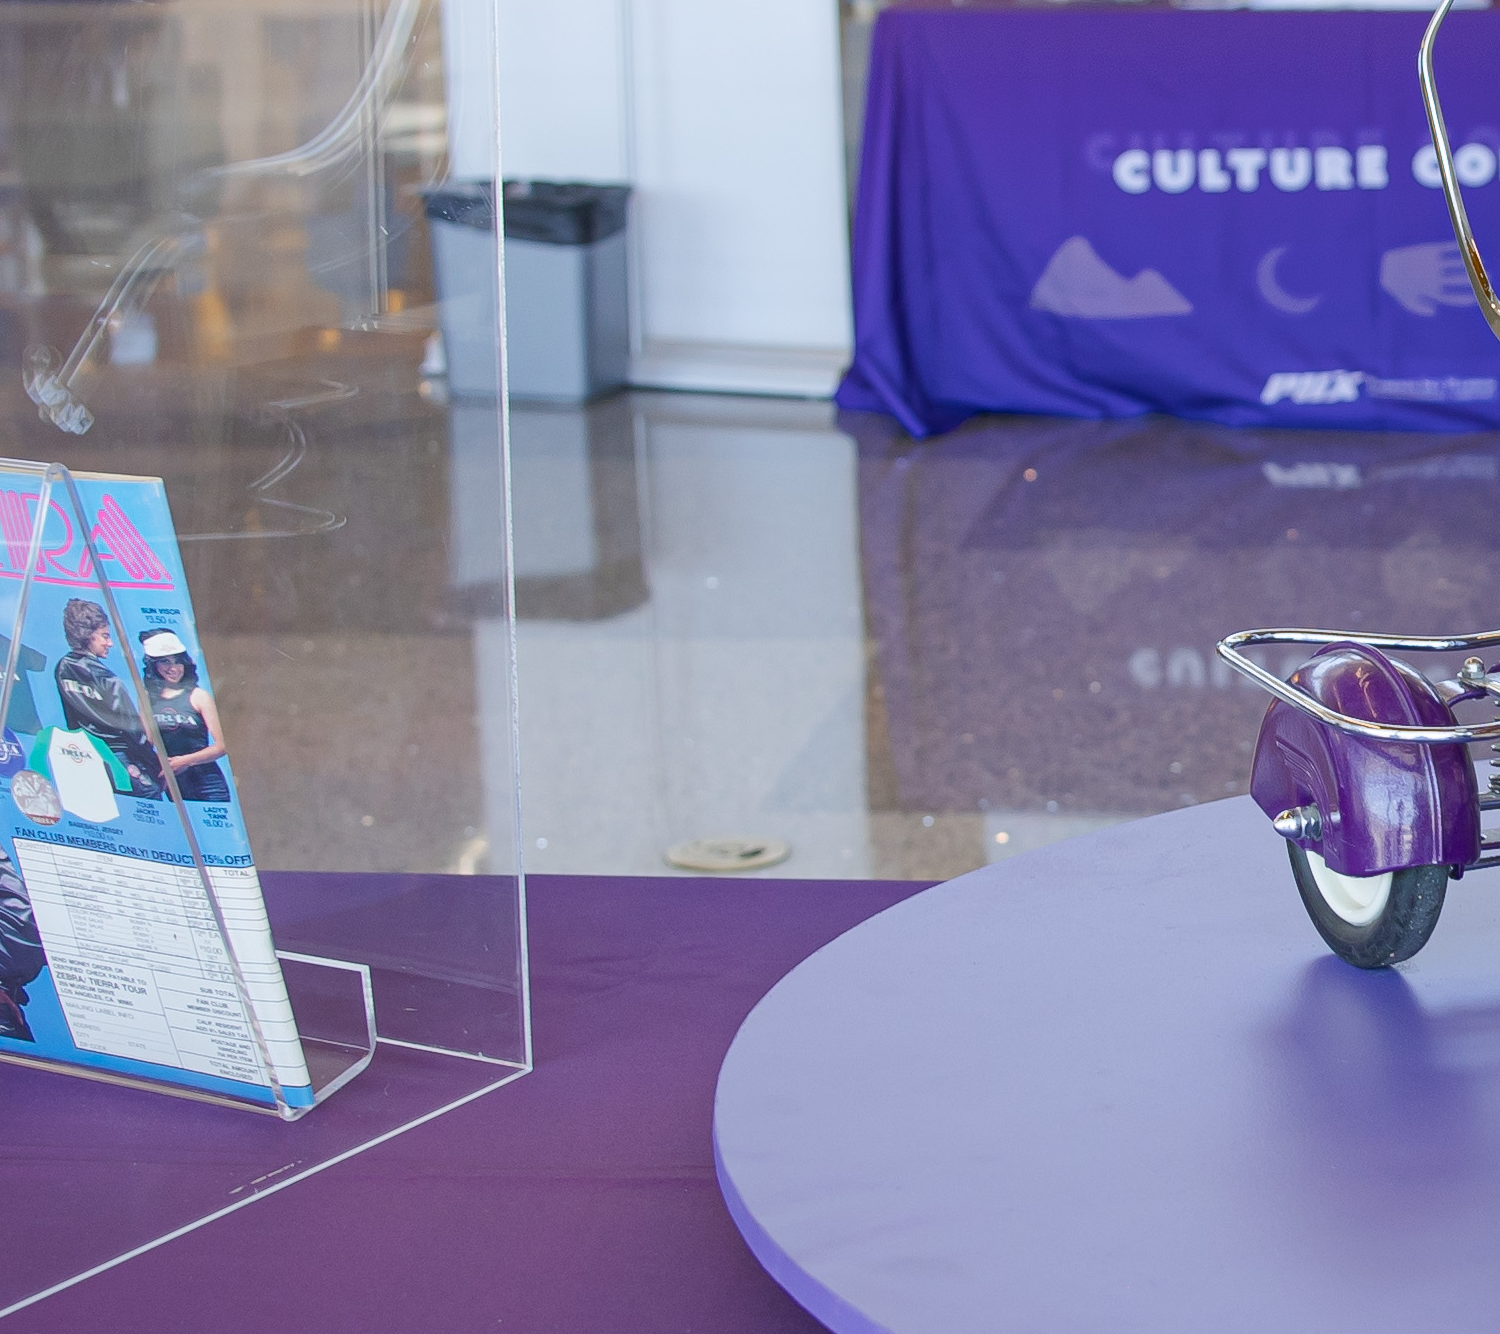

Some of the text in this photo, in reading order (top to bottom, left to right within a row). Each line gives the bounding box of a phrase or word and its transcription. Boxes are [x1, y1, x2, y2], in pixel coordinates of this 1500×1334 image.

[1112, 144, 1391, 194] CULTURE
[15, 826, 36, 838] FAN
[37, 829, 66, 843] CLUB
[66, 836, 118, 853] MEMBERS
[119, 844, 149, 860] ONLY!
[152, 850, 196, 865] DEDUCT
[223, 869, 250, 877] TOTAL
[88, 977, 121, 990] TIERRA
[121, 983, 148, 996] TOUR
